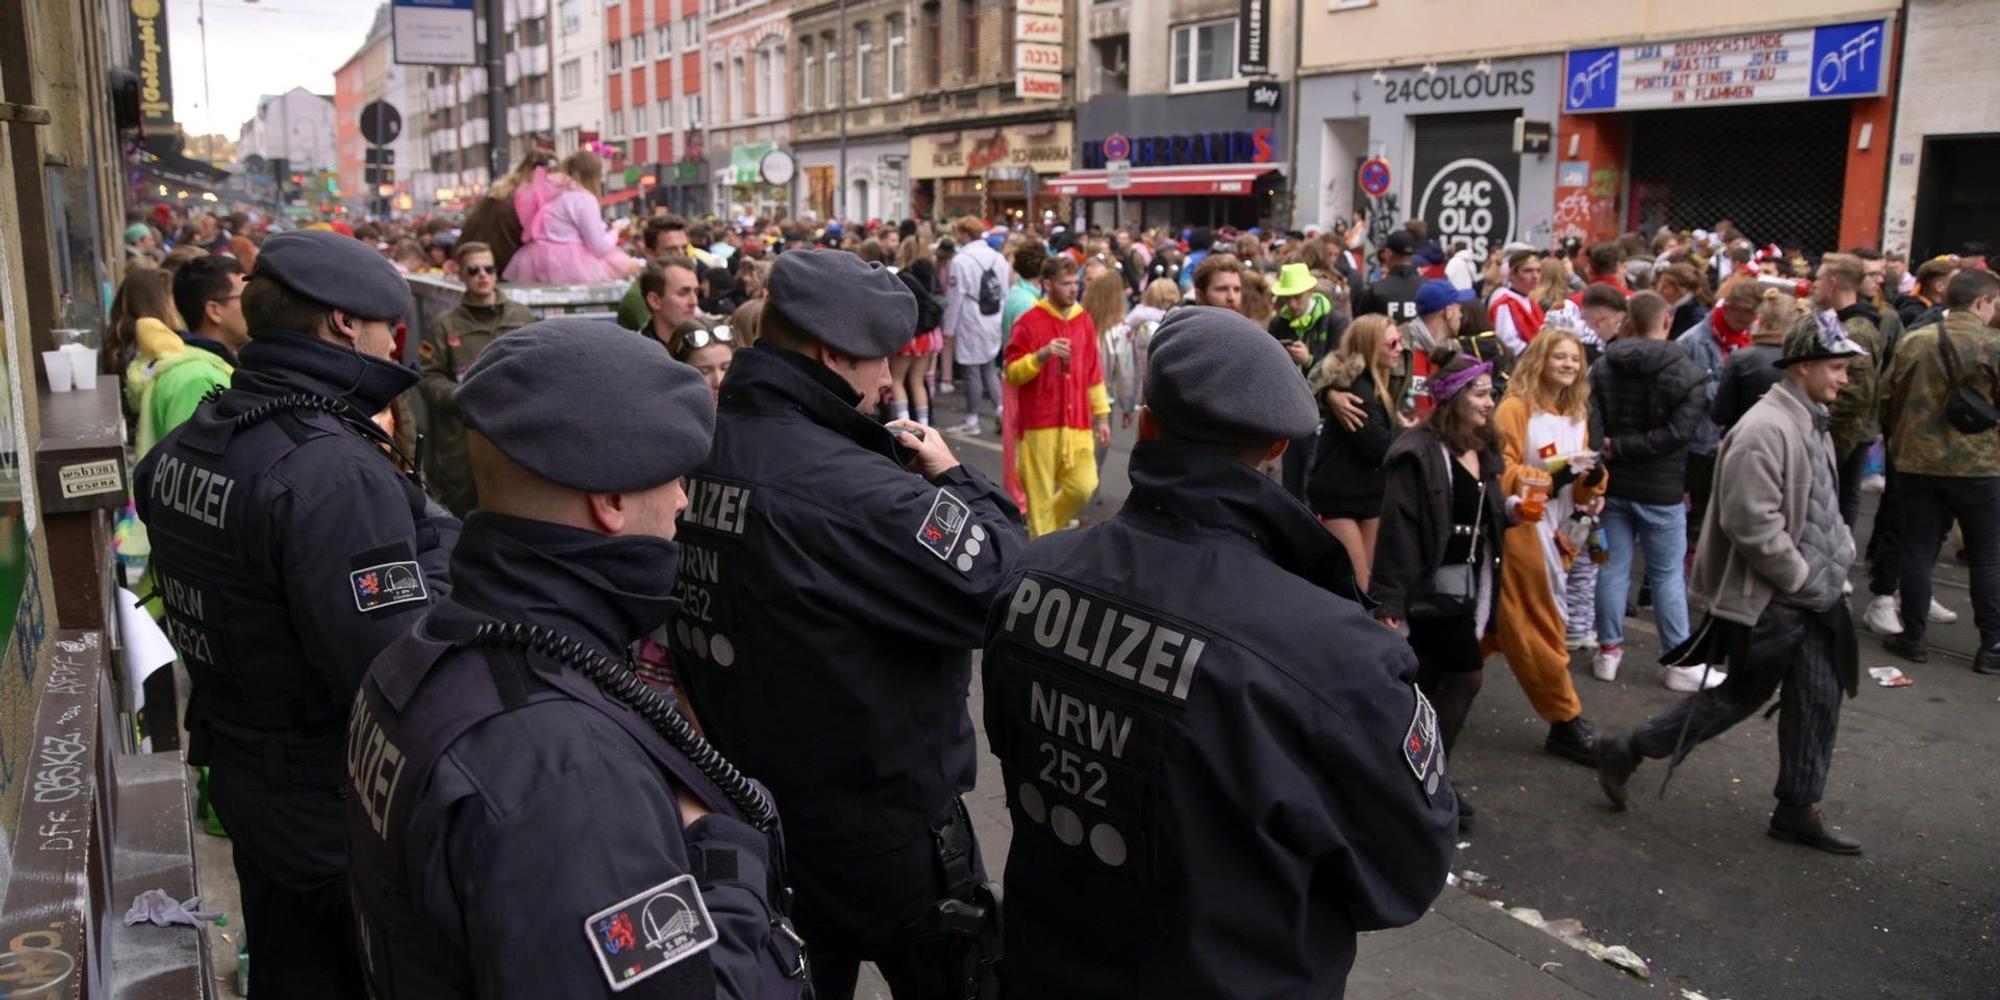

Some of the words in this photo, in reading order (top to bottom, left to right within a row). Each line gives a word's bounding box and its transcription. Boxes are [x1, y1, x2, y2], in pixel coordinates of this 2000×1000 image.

[1662, 57, 1721, 73] PARASITE
[1747, 49, 1789, 66] JOKER
[1674, 34, 1784, 57] DEUTSCHSTUNDE
[1816, 26, 1880, 93] OFF
[1384, 70, 1535, 103] 24COLOURS
[1569, 51, 1615, 108] OFF
[1634, 73, 1690, 90] PORTRAIT
[1697, 71, 1733, 85] EINER
[1743, 67, 1776, 82] FRAU
[1672, 89, 1685, 103] IN
[1695, 85, 1755, 101] FLAMMEN
[1254, 86, 1278, 107] sky
[1441, 180, 1492, 207] 24C
[1438, 208, 1493, 234] OLO
[66, 477, 116, 494] Cesena
[151, 453, 235, 529] POLIZEI
[681, 477, 751, 535] LIZEI
[1004, 577, 1207, 701] POLIZEI
[1030, 680, 1134, 759] NRW
[348, 687, 407, 841] POLIZEI
[1038, 742, 1108, 808] 252
